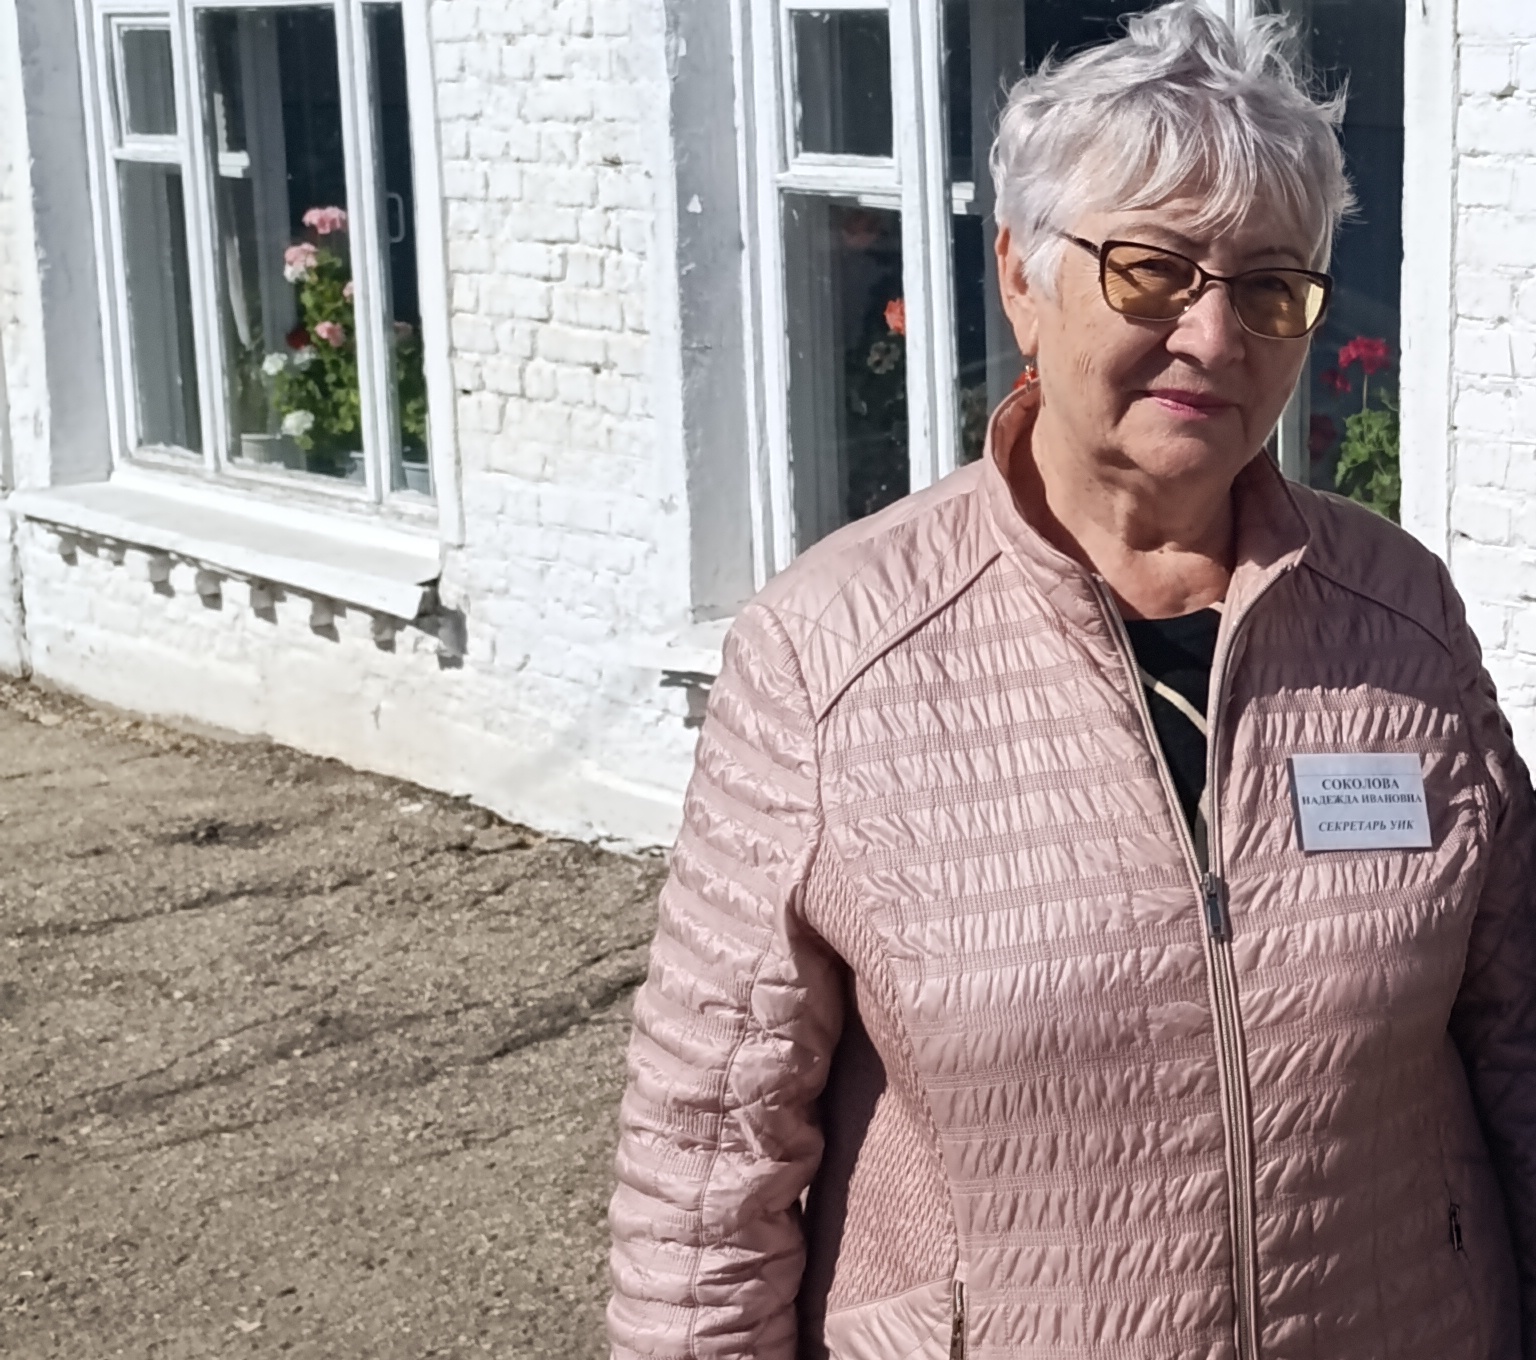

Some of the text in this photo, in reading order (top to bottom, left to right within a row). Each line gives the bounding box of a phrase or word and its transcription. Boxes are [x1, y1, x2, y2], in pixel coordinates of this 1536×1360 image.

[1321, 778, 1400, 791] СОКОЛОВА
[1302, 793, 1423, 806] НАДЕЖДА ИВАНОВНА
[1318, 820, 1415, 832] СЕКРЕТАРЬ УИК
